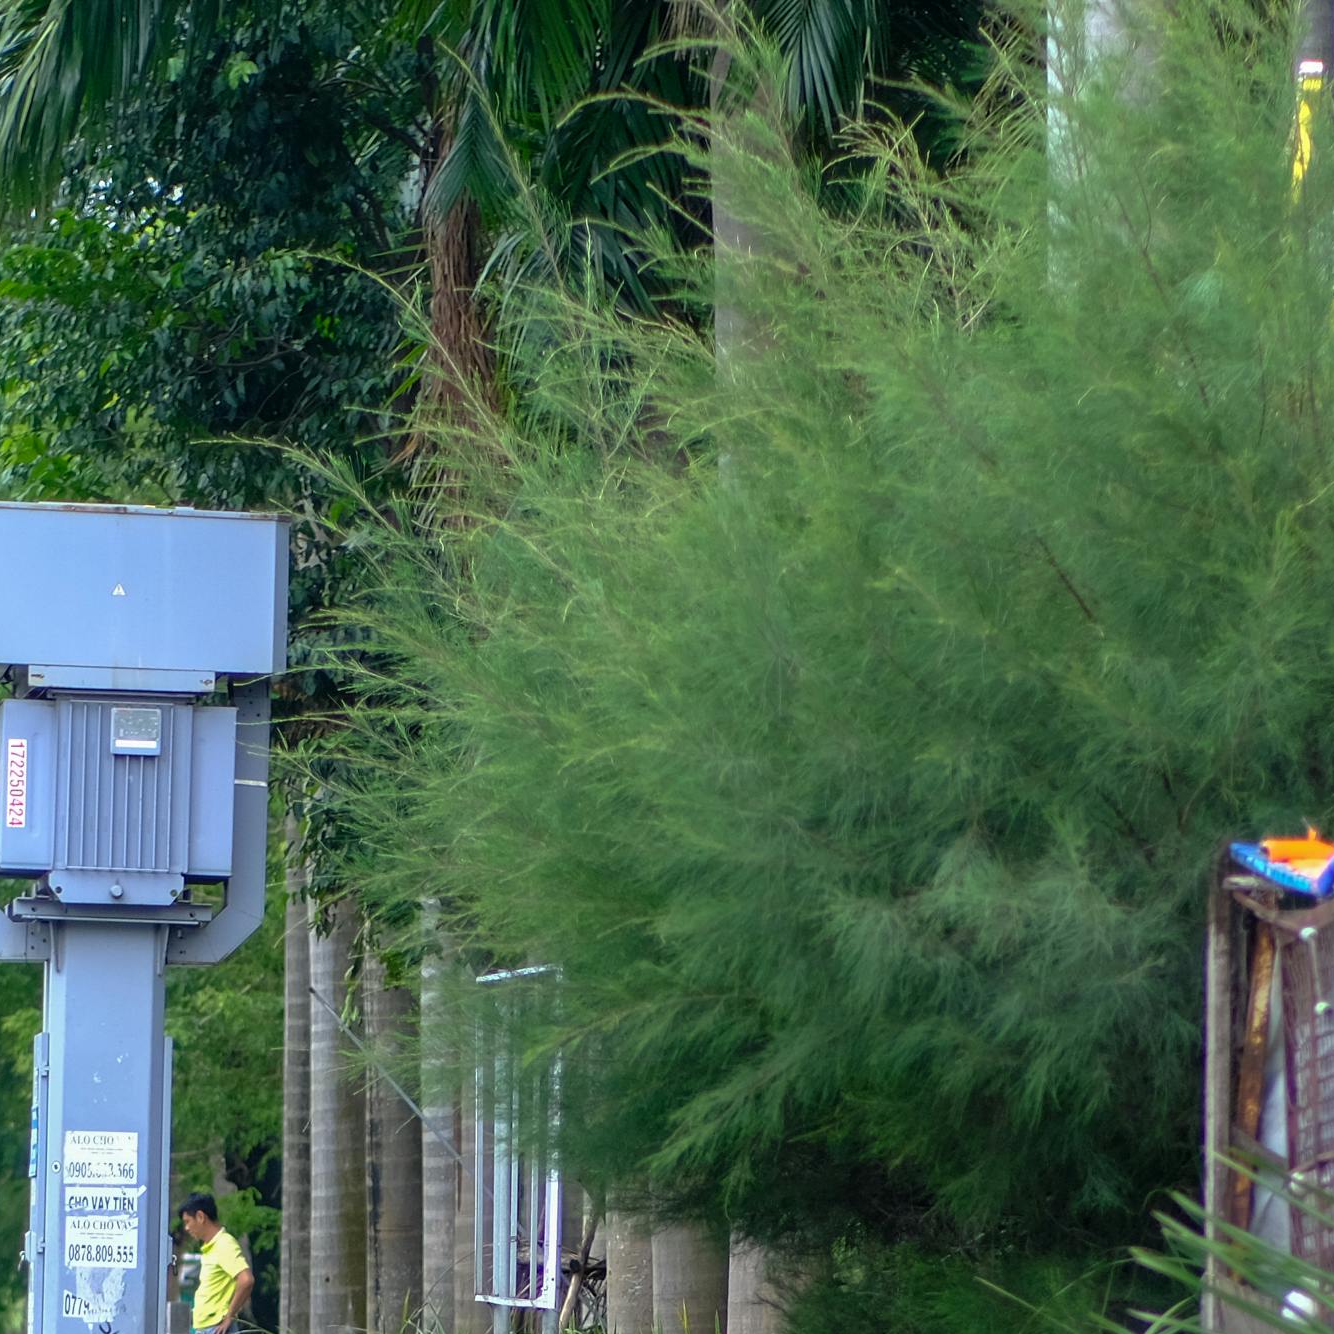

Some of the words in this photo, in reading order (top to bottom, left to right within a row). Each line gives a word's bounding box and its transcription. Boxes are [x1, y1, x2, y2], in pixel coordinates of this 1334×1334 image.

[8, 741, 25, 826] 172250424
[68, 1195, 89, 1209] CHO
[91, 1196, 111, 1210] VAY
[68, 1243, 134, 1264] 0878.809.555
